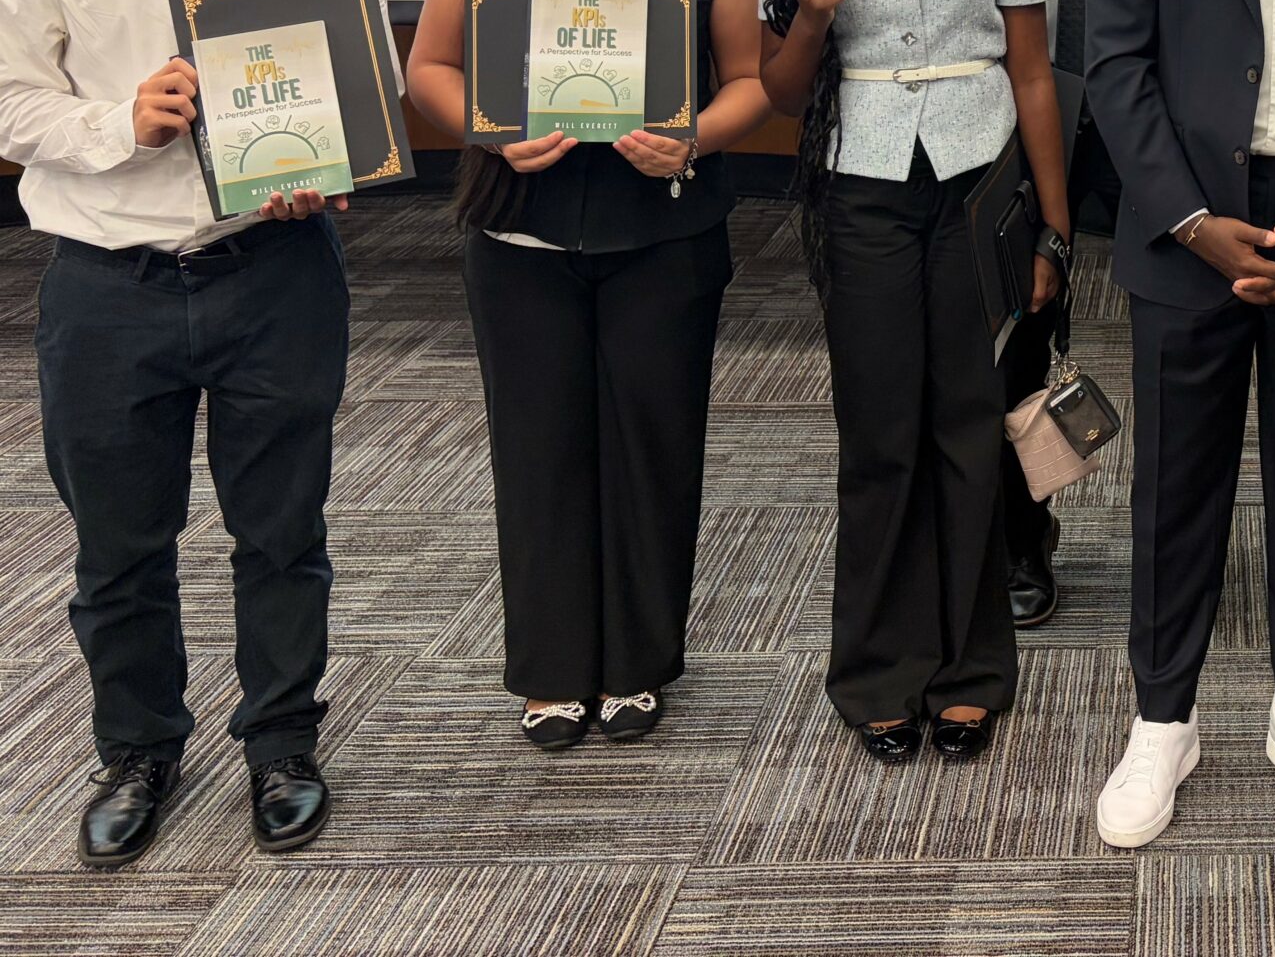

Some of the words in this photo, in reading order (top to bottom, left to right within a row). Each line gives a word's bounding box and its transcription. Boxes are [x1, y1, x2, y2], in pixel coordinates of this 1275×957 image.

[557, 27, 578, 48] OF
[582, 28, 617, 49] LIFE
[245, 44, 274, 61] THE
[546, 48, 590, 57] Perspective
[591, 47, 602, 55] for
[602, 49, 632, 57] Success
[232, 86, 257, 109] OF
[262, 78, 303, 104] LIFE
[225, 107, 274, 122] Perspective
[275, 102, 288, 111] for
[289, 98, 322, 109] Success
[554, 122, 575, 130] WILL
[580, 122, 618, 130] EVERETT
[251, 185, 275, 196] WILL
[280, 176, 323, 191] EVERETT
